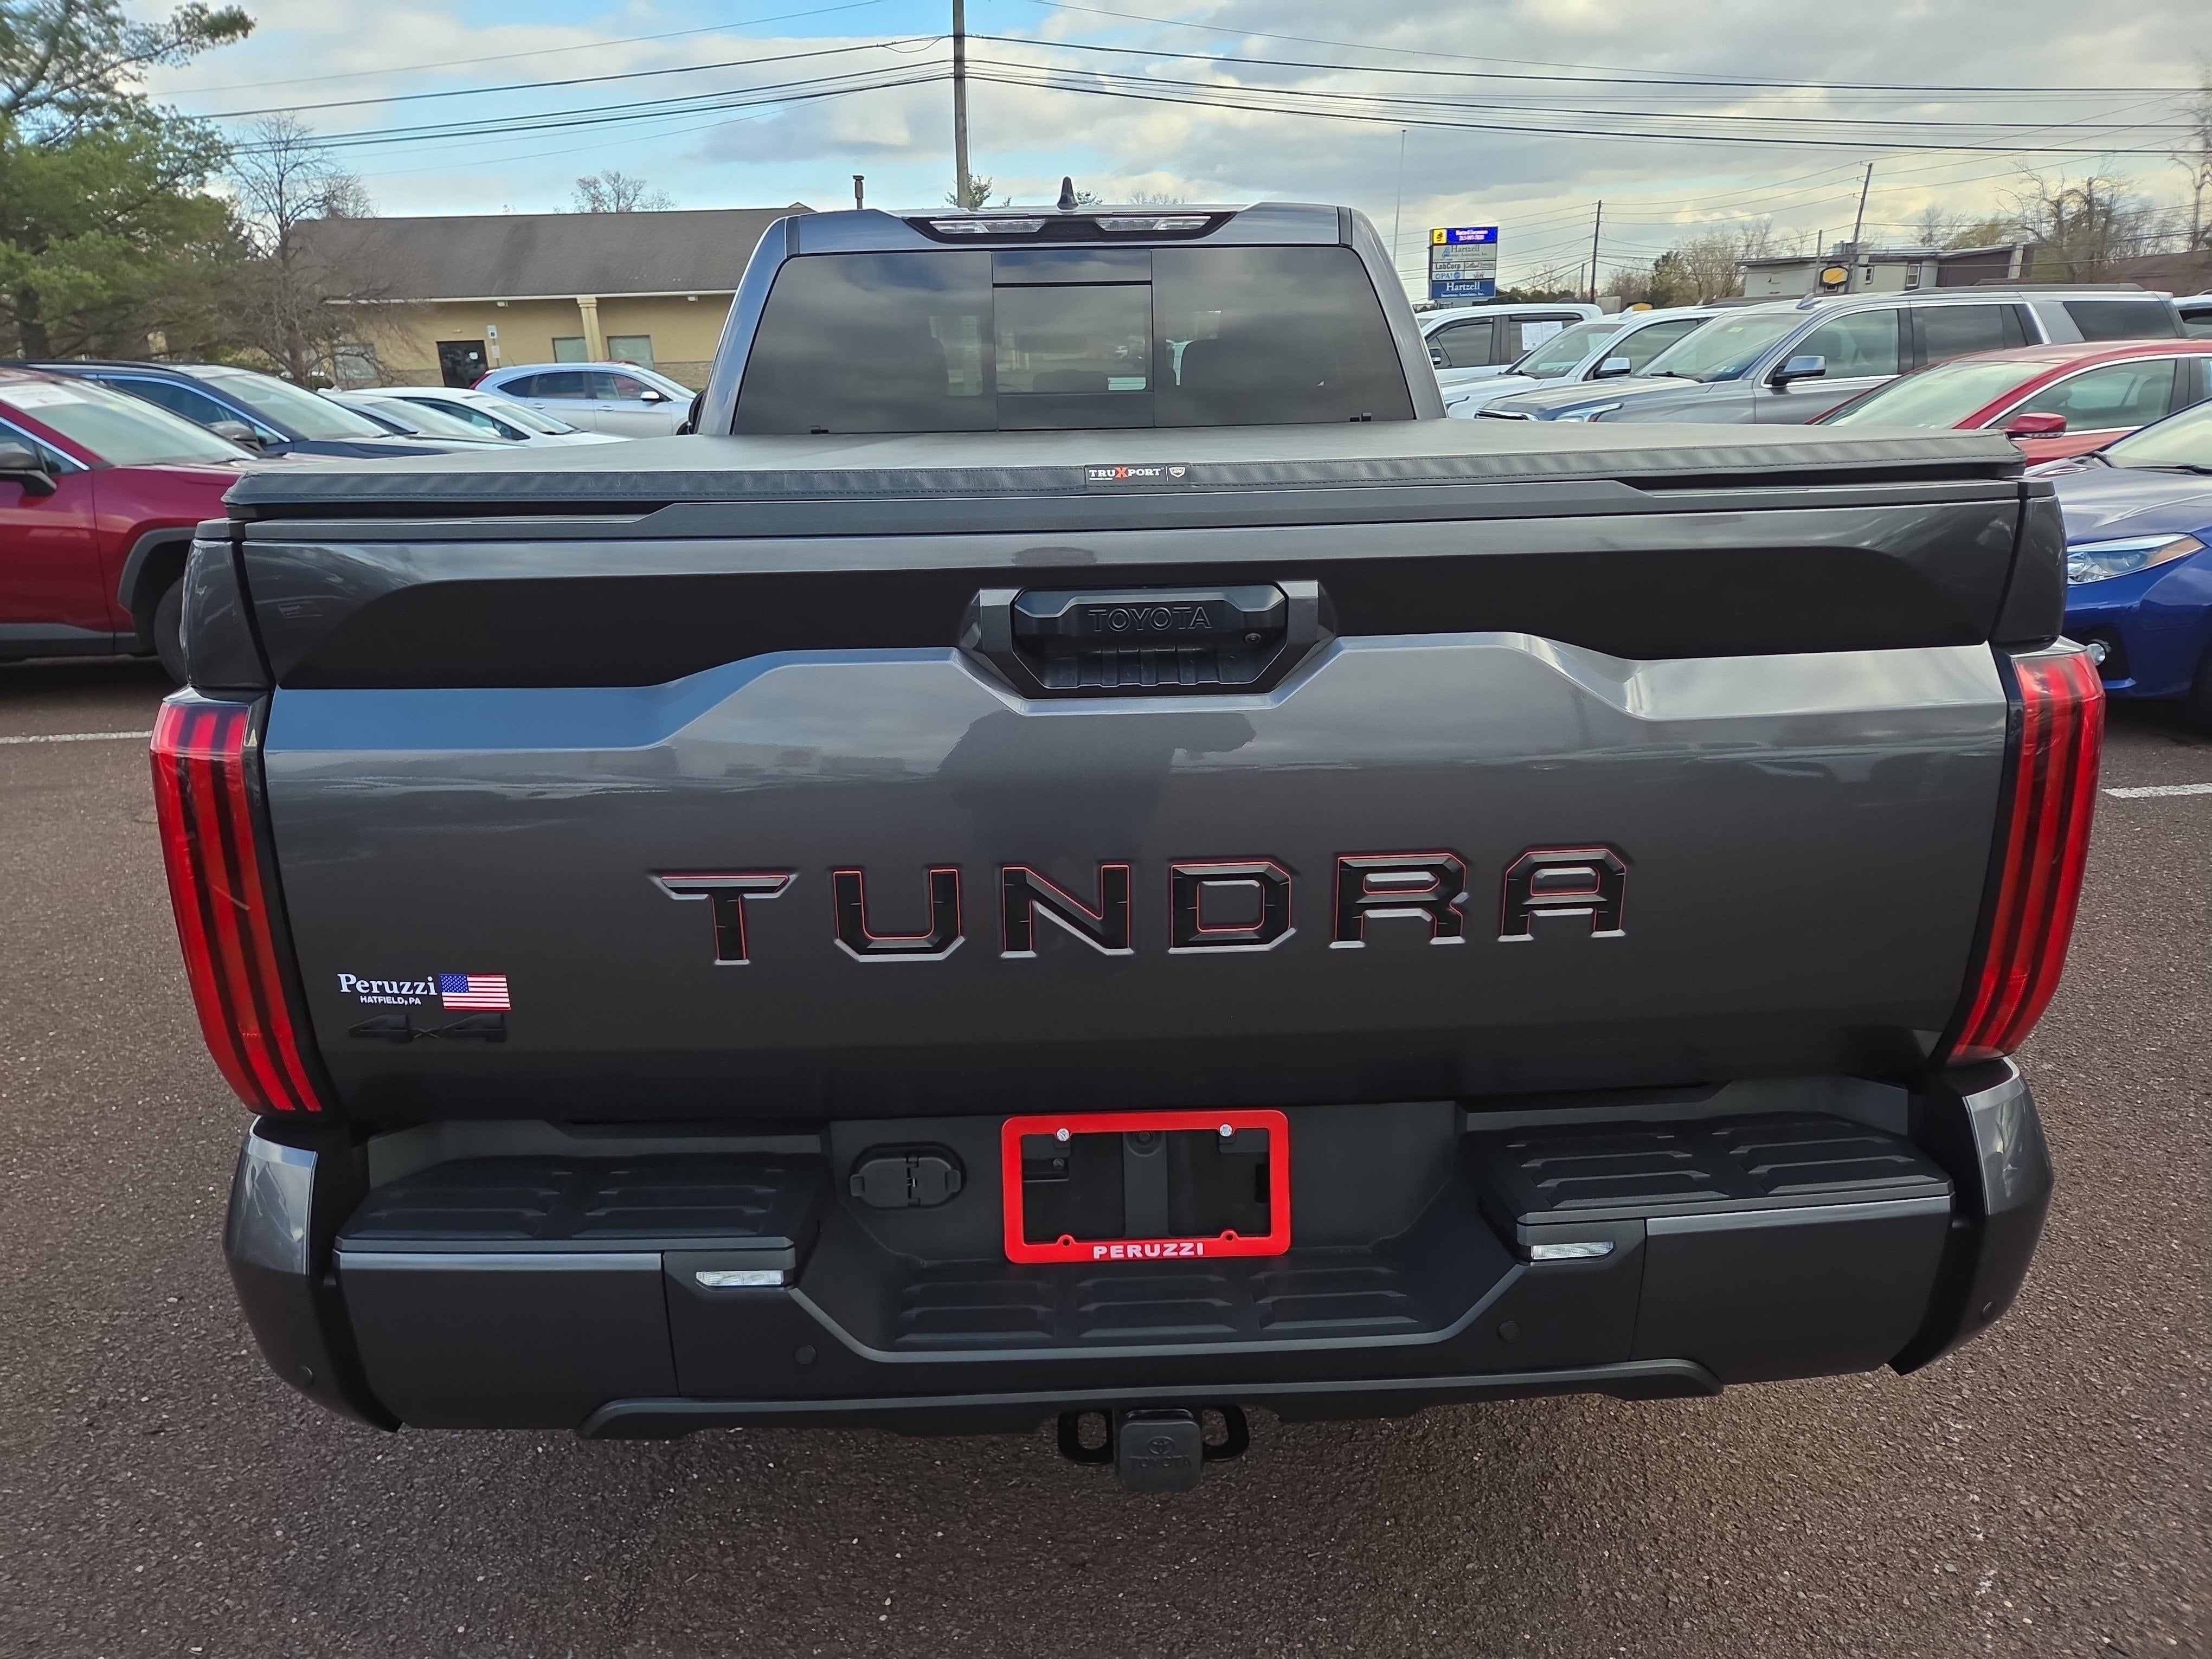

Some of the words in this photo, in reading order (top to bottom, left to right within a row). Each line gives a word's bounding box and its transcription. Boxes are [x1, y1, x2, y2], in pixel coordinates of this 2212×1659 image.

[1451, 245, 1480, 253] Hartzell
[1436, 262, 1461, 271] LabCorp
[1446, 281, 1481, 291] Hartzell
[1089, 467, 1161, 478] TRUXPORT
[1088, 606, 1213, 632] TOYOTA
[649, 847, 1627, 965] TUNDRA
[337, 973, 438, 995] Peruzzi
[409, 997, 422, 1005] PA
[1093, 1242, 1204, 1259] PERUZZI
